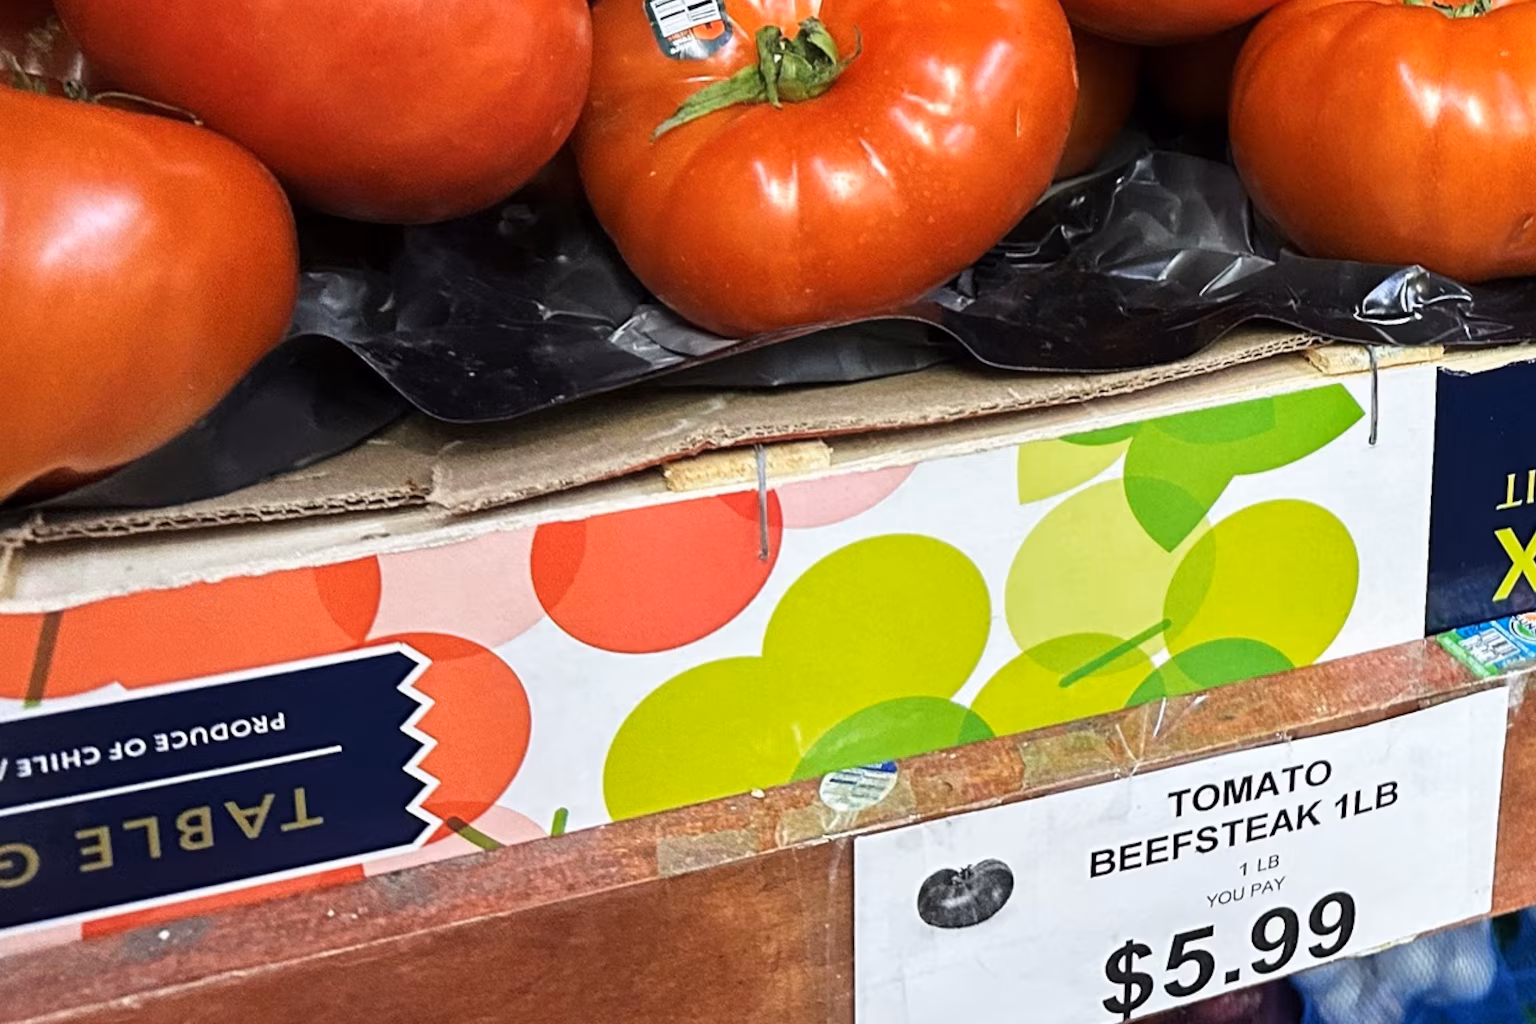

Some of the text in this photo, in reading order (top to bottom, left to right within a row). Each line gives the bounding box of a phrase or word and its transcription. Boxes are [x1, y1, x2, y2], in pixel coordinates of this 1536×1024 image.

[108, 737, 147, 760] OF
[154, 712, 286, 753] PRODUCE
[16, 746, 101, 778] CHILE
[1168, 760, 1333, 818] TOMATO
[75, 787, 324, 873] TABLE
[1089, 780, 1400, 879] BEEFSTEAK 1LB
[1238, 854, 1281, 876] 1 LB
[1206, 877, 1287, 909] YOU PAY
[1101, 891, 1357, 1020] $5.99
